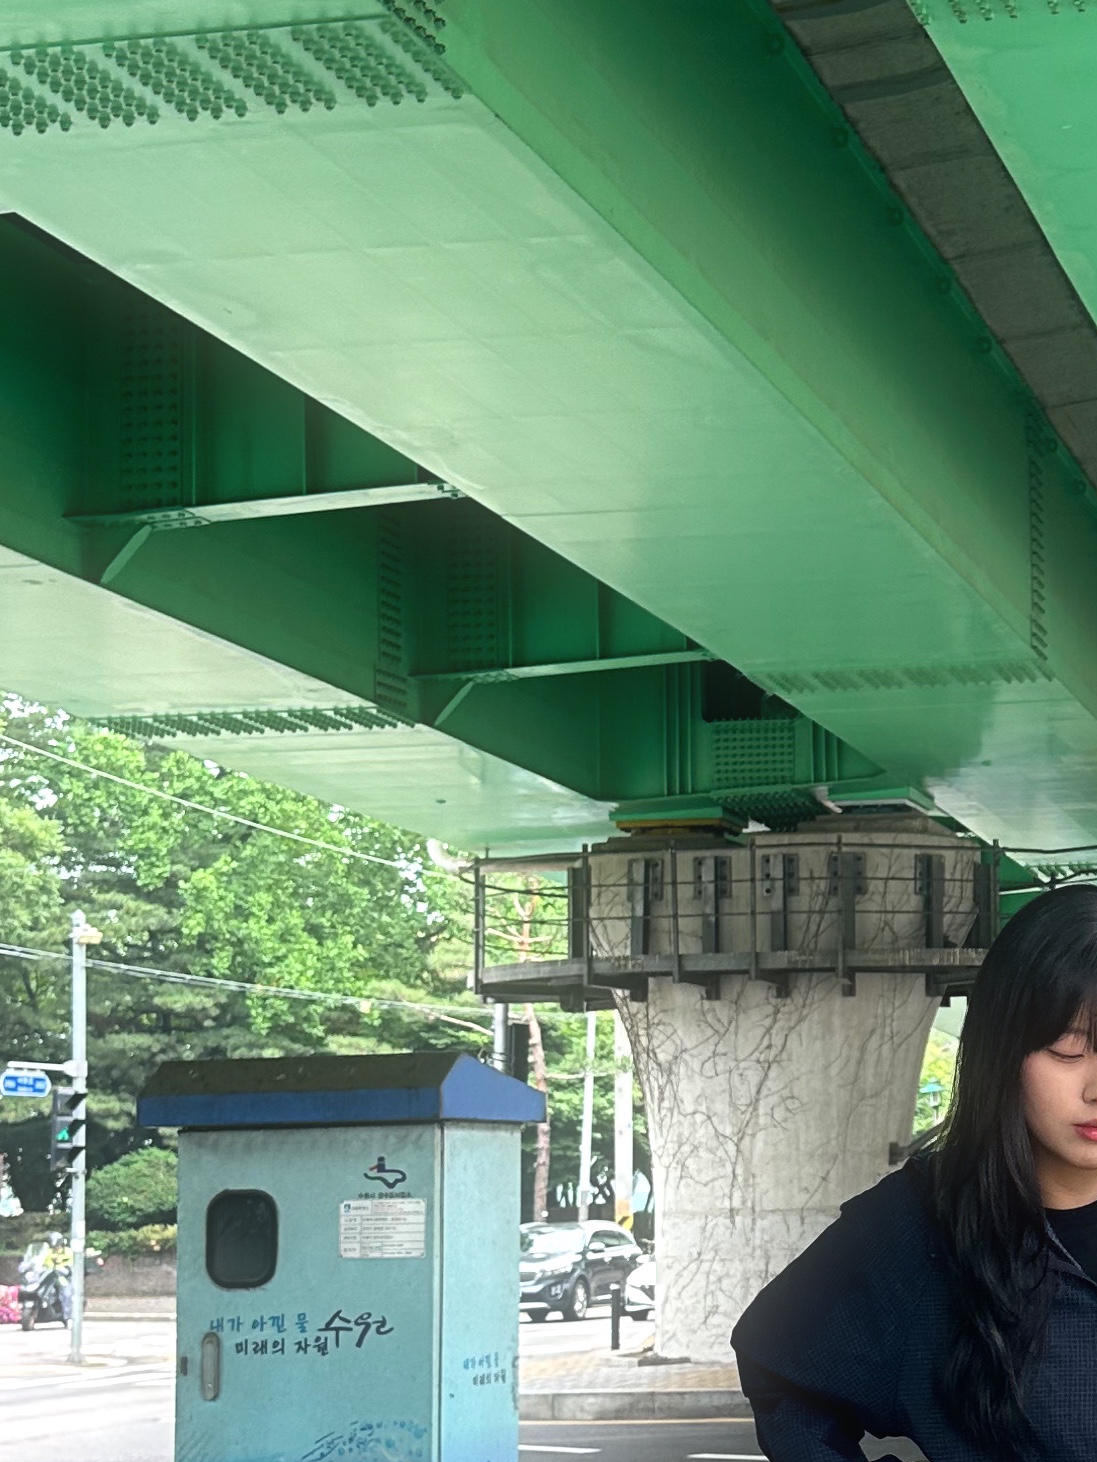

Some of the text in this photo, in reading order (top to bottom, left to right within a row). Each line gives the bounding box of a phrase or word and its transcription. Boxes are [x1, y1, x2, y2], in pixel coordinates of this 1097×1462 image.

[209, 1312, 309, 1334] 내가 아낀 물
[235, 1335, 330, 1357] 미래의 자원
